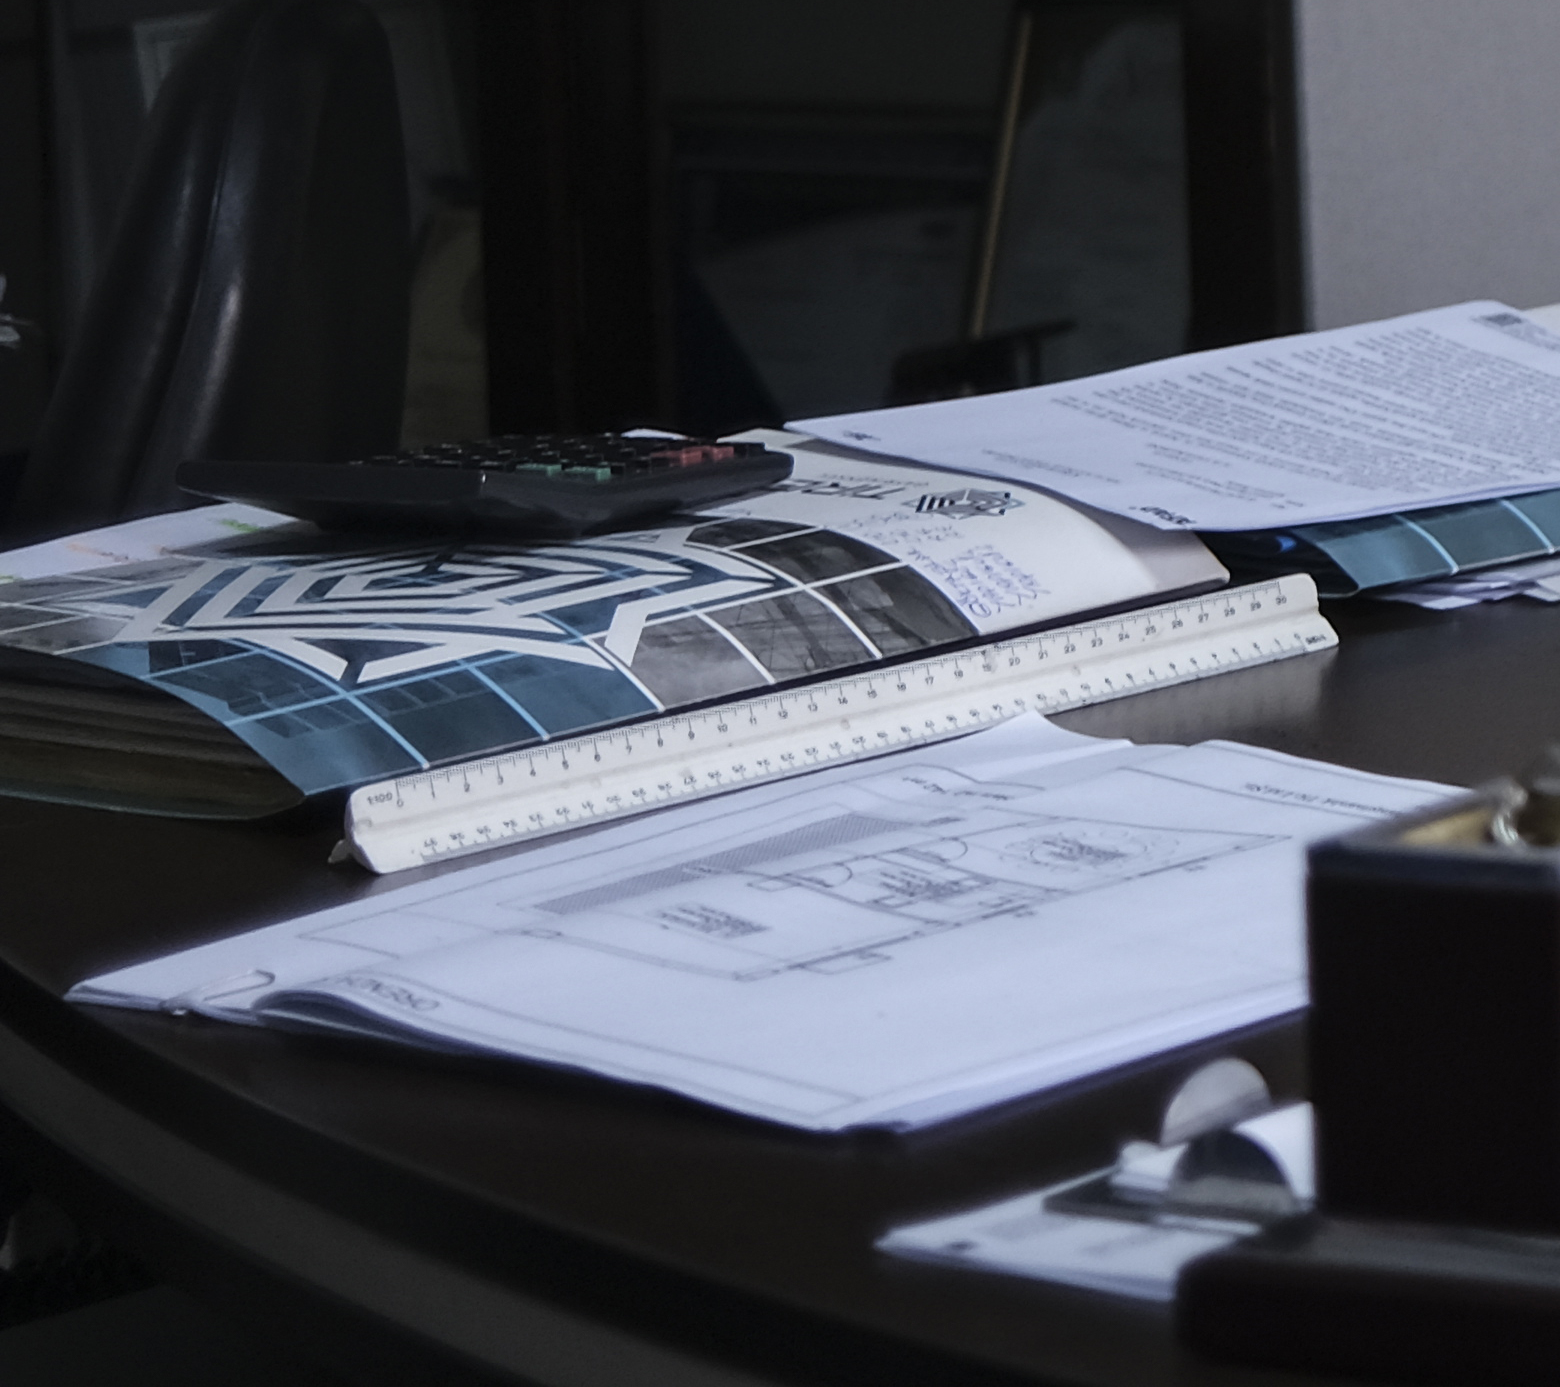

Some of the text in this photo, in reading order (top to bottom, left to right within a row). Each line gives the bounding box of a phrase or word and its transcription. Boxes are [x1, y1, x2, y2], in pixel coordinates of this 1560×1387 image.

[784, 478, 905, 501] TIRE
[717, 723, 728, 733] 10
[749, 716, 757, 725] 11
[778, 710, 788, 719] 12
[808, 703, 818, 712] 13
[837, 696, 848, 705] 14
[867, 690, 878, 698] 15
[925, 676, 934, 685] 17
[954, 669, 964, 678] 18
[1008, 657, 1020, 666] 20
[1038, 651, 1048, 660] 21
[1064, 644, 1076, 654] 22
[1091, 637, 1103, 647] 23
[1118, 632, 1130, 642] 24
[1145, 626, 1157, 635] 25
[1171, 619, 1183, 629] 26
[1198, 613, 1209, 623] 27
[1224, 608, 1236, 617] 28
[1250, 601, 1262, 611] 29
[1276, 595, 1287, 605] 30
